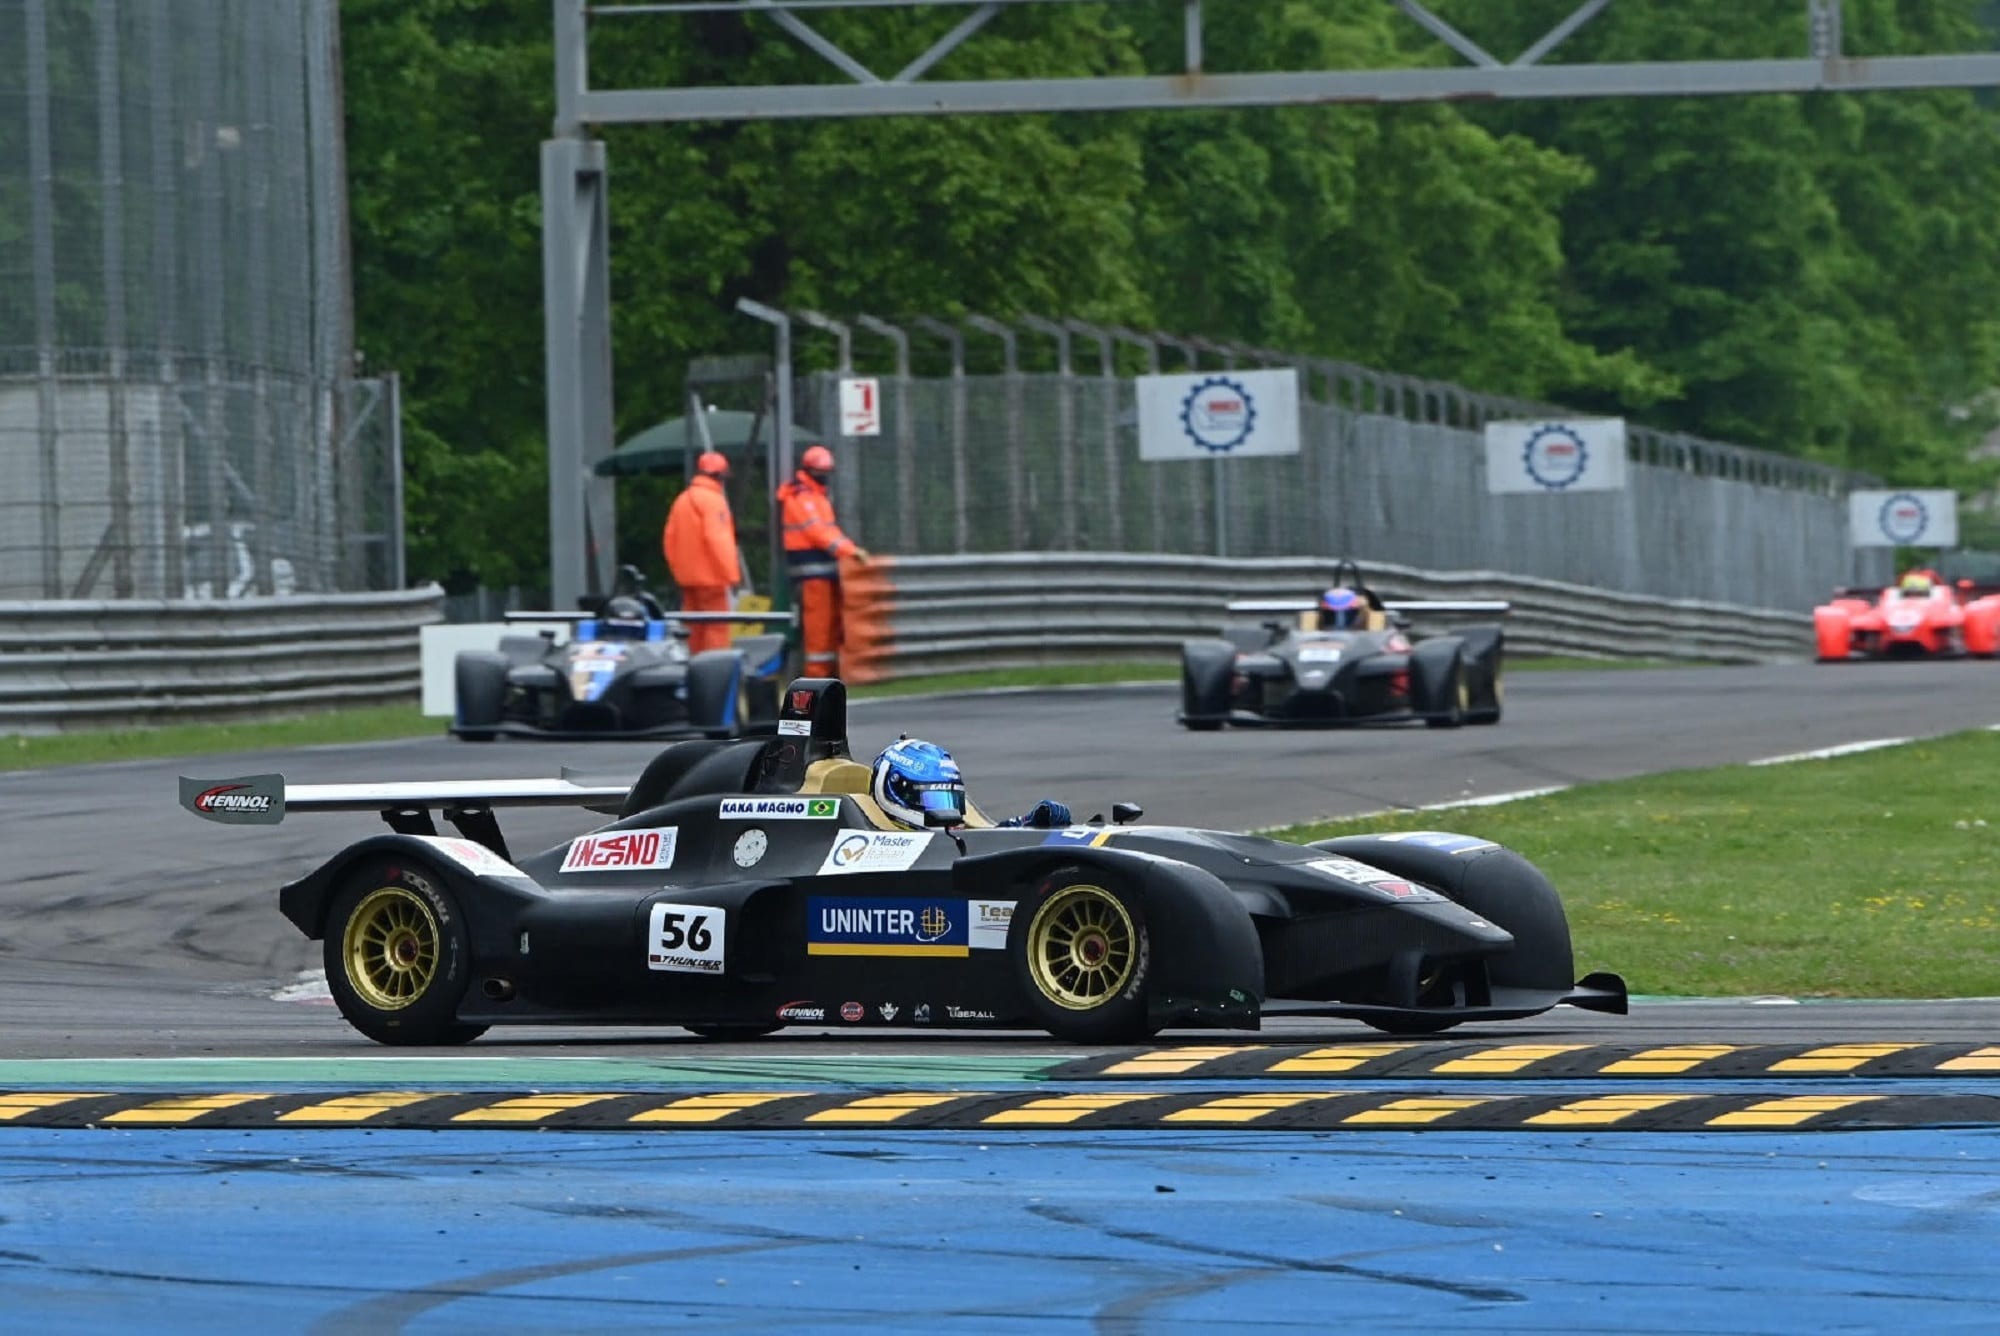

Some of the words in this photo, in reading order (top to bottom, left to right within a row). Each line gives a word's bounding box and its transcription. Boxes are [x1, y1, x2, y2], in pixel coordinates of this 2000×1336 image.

[200, 795, 270, 808] KENNOL
[722, 802, 753, 813] KAKA
[756, 802, 805, 813] MAGNO
[872, 835, 914, 847] Master
[978, 904, 1014, 917] Tea
[822, 908, 914, 935] UNINTER
[661, 912, 712, 952] 56
[662, 955, 722, 967] THUNDER
[780, 1007, 825, 1017] KENNOL
